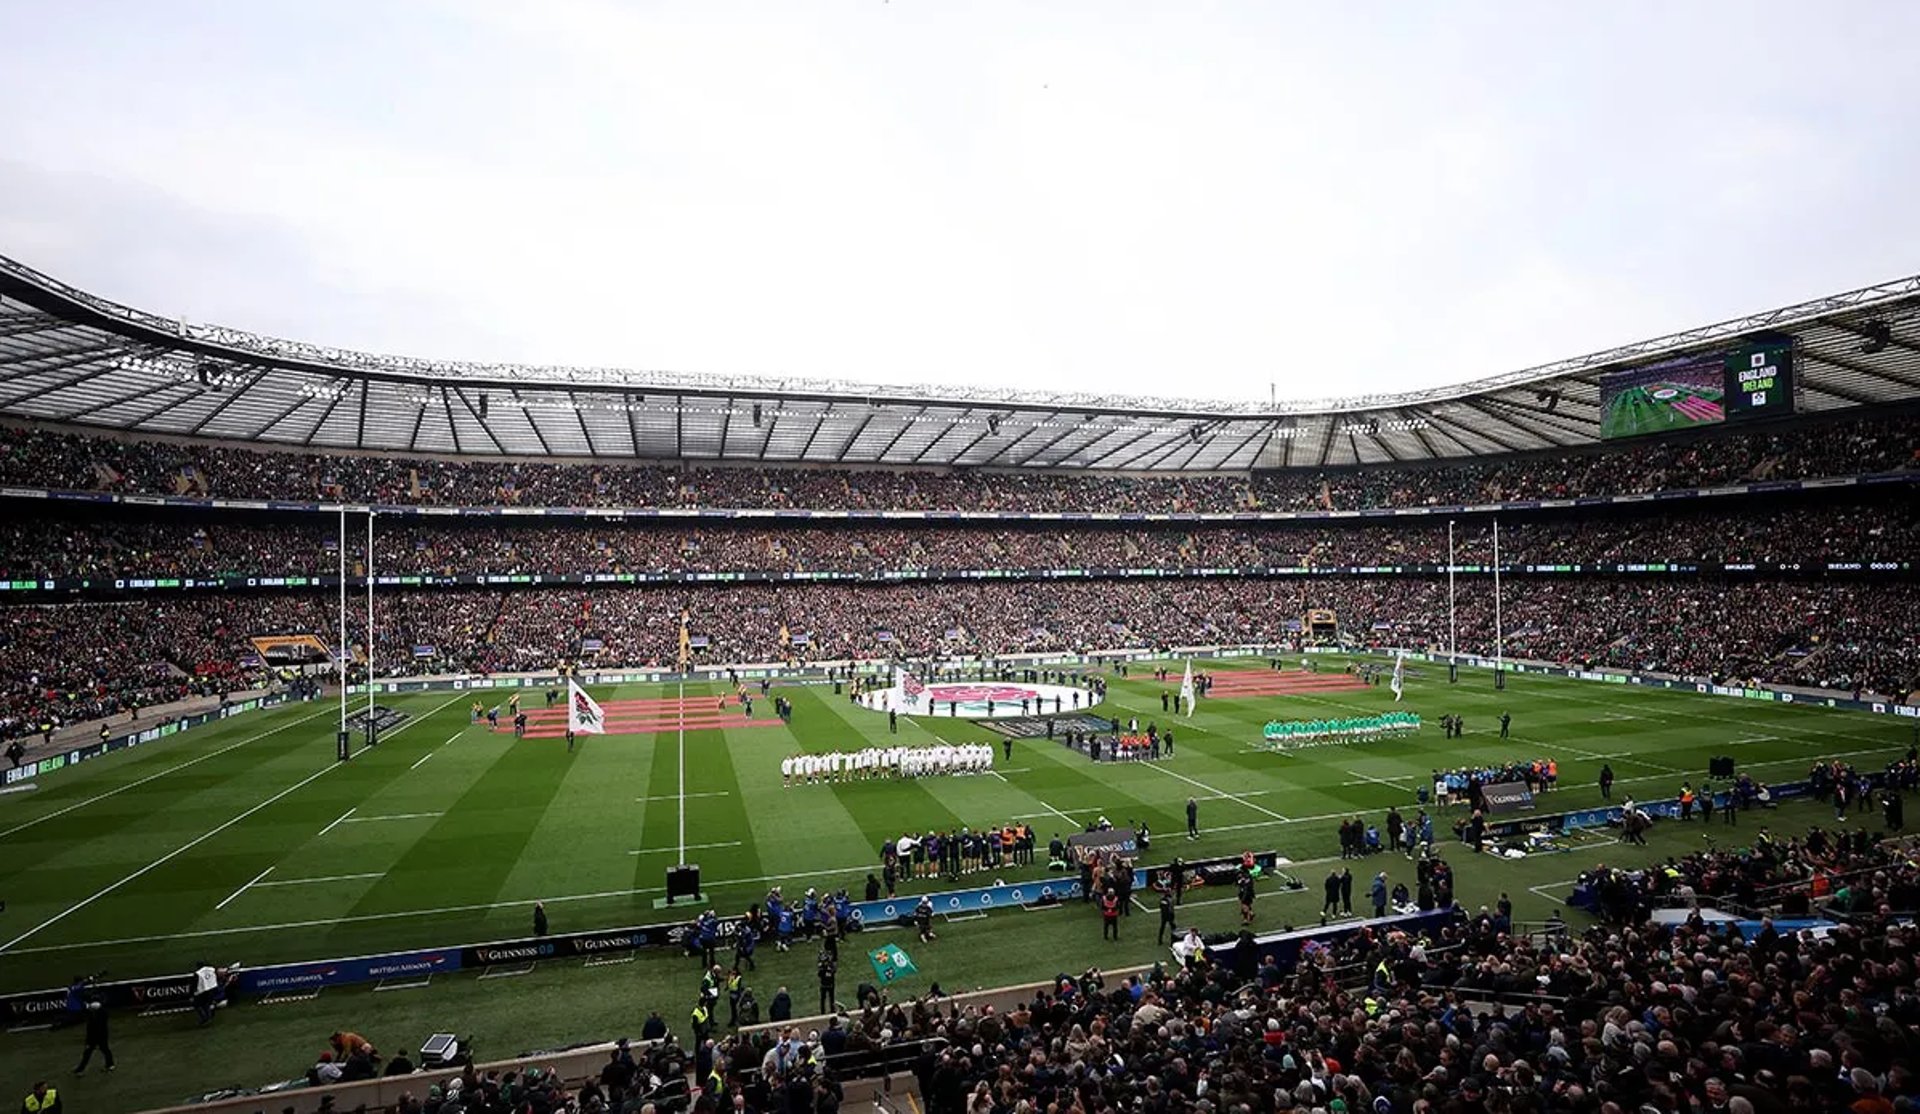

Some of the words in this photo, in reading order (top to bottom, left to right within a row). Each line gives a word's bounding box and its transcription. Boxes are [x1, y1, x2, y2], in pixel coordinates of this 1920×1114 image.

[1739, 365, 1777, 382] ENGLAND
[1743, 378, 1773, 391] IRELAND
[1894, 704, 1920, 717] ENGL
[585, 936, 632, 950] GUINNESS
[489, 946, 538, 960] GUINNESS
[147, 985, 191, 999] GUINNE
[26, 999, 68, 1013] GUINN
